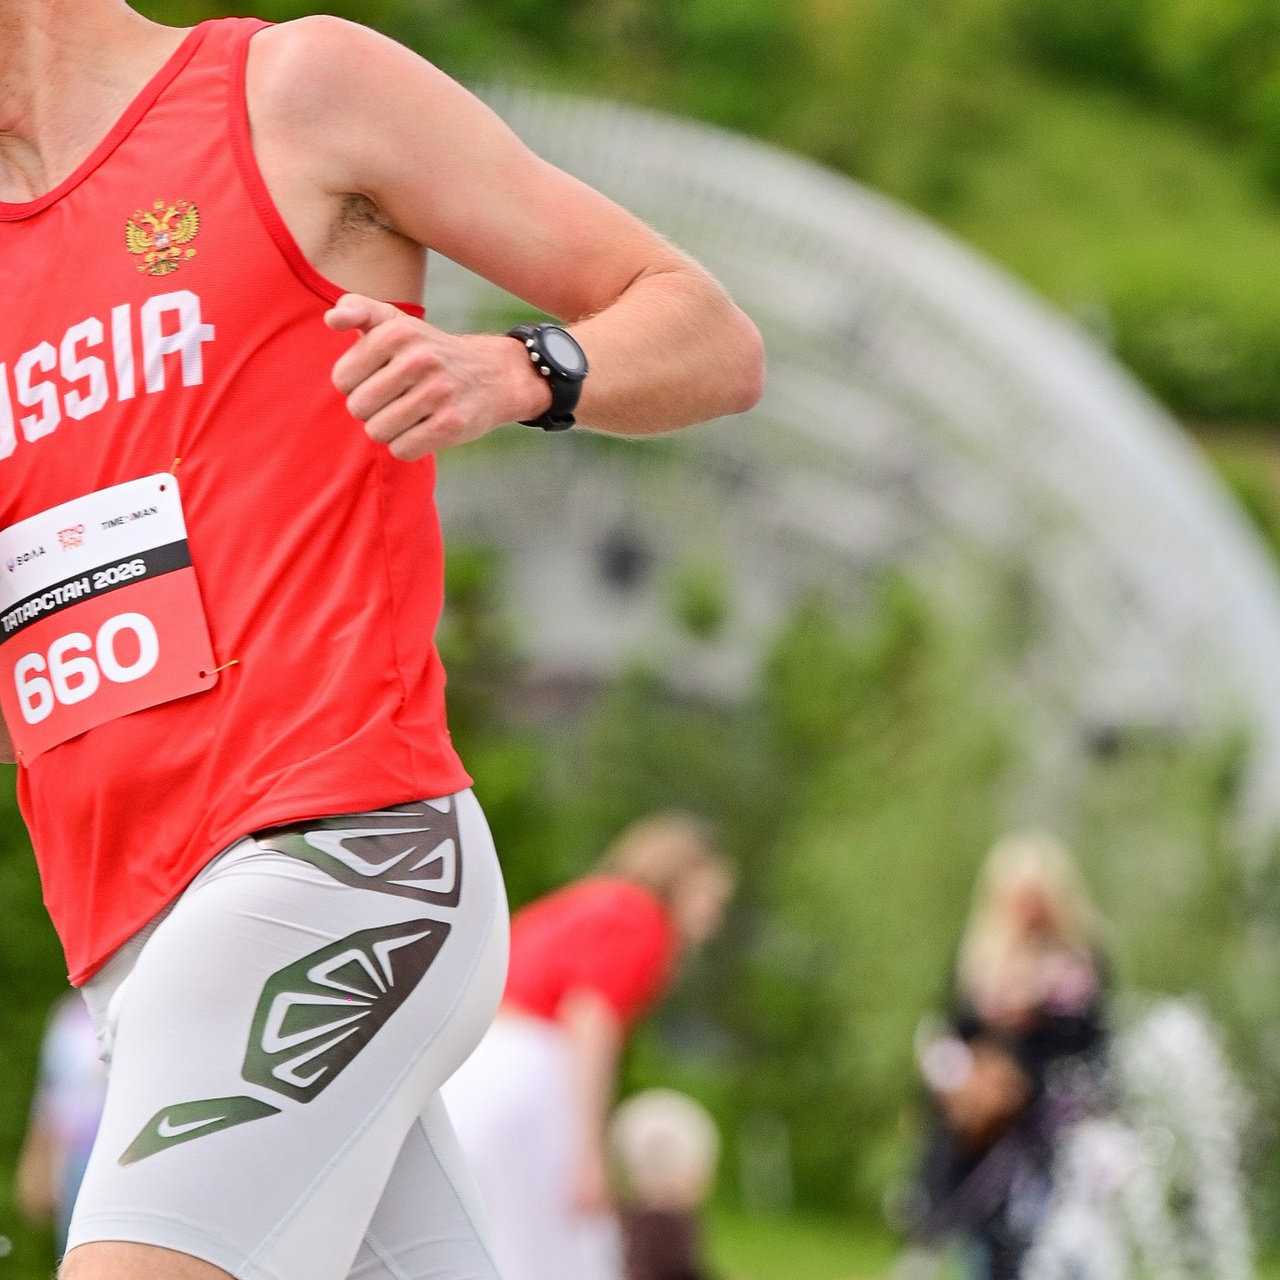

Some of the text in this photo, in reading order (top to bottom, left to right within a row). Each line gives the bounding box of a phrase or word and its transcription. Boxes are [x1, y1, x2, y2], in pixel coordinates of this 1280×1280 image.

[0, 577, 91, 633] ТАТАРСТАН
[93, 559, 147, 590] 2026
[14, 613, 159, 725] 660
